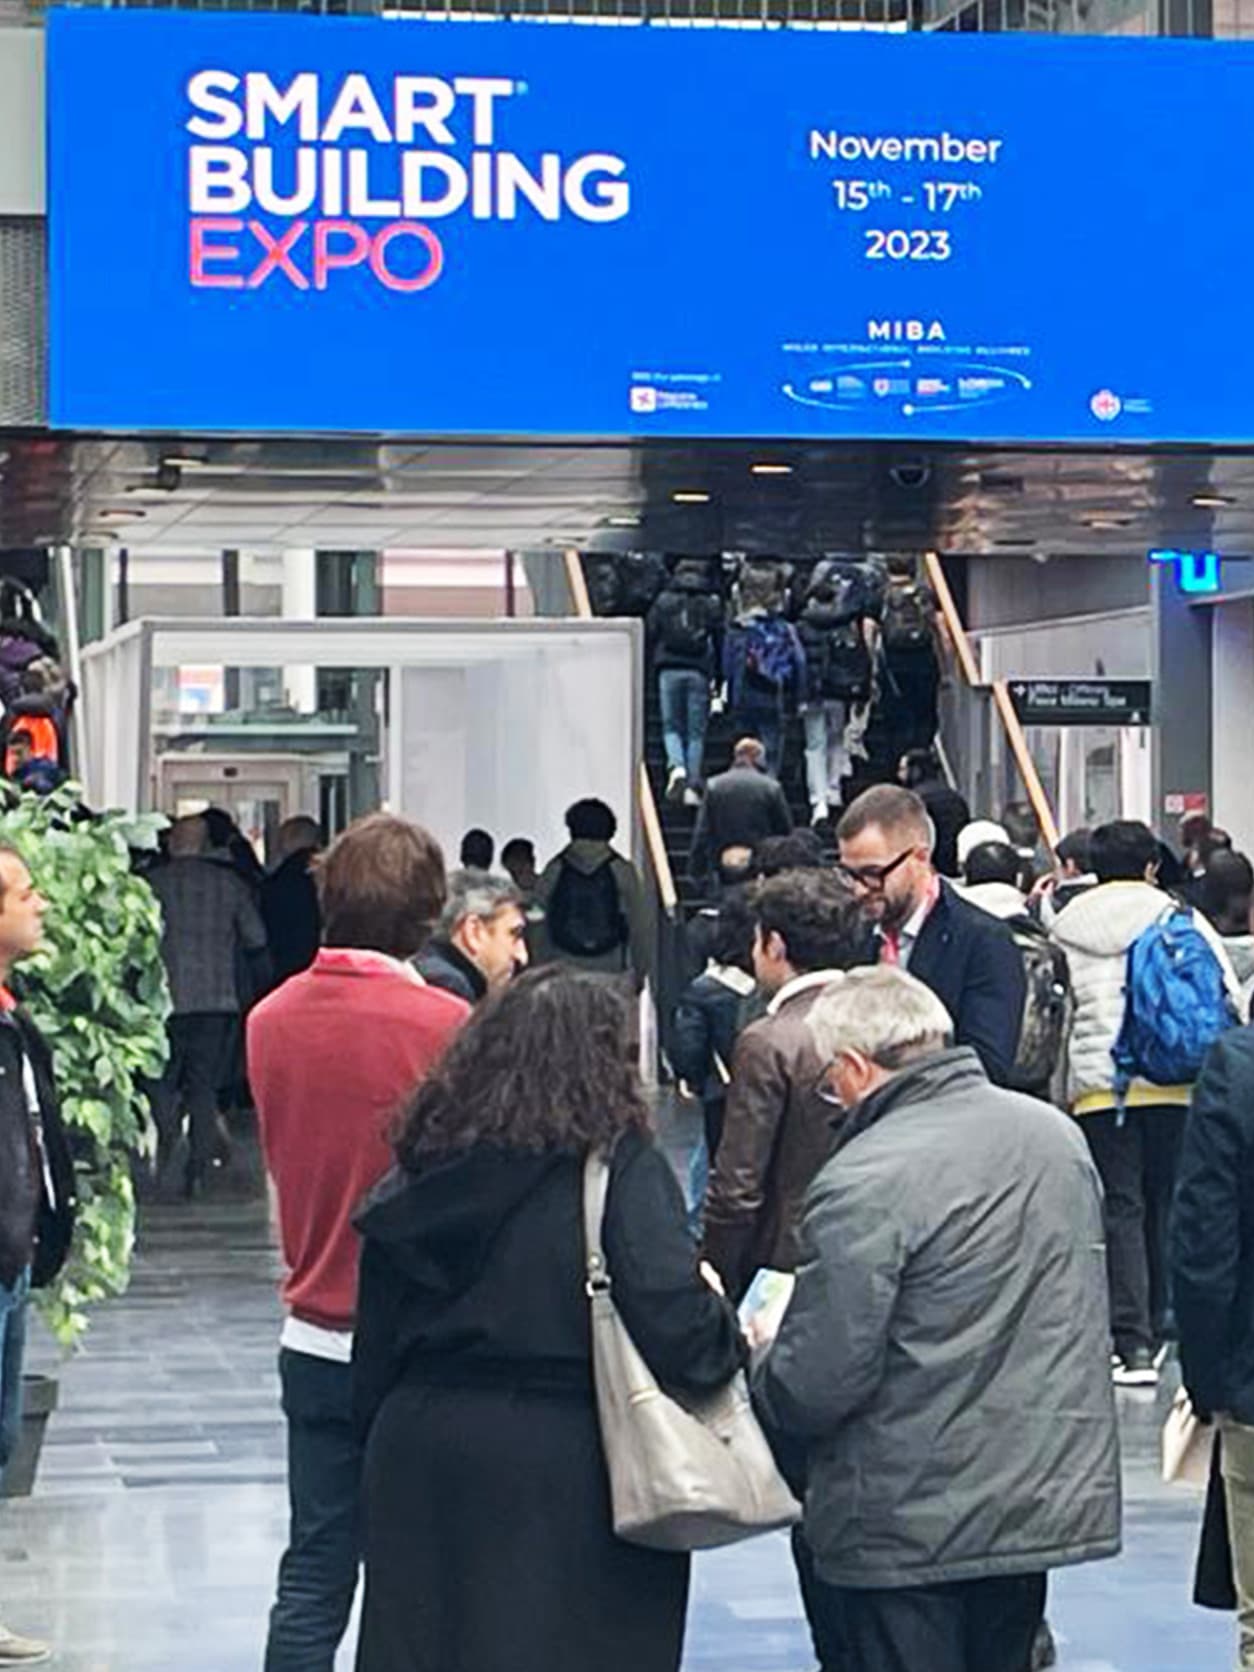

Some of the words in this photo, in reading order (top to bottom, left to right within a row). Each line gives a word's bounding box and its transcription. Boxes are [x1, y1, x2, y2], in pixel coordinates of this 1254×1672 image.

[185, 69, 514, 146] SMART
[809, 129, 1004, 164] November
[188, 144, 631, 222] BUILDING
[832, 179, 893, 212] 15th
[921, 181, 984, 213] 17th
[189, 217, 444, 293] EXPO
[864, 228, 952, 261] 2023
[867, 320, 947, 341] MIBA
